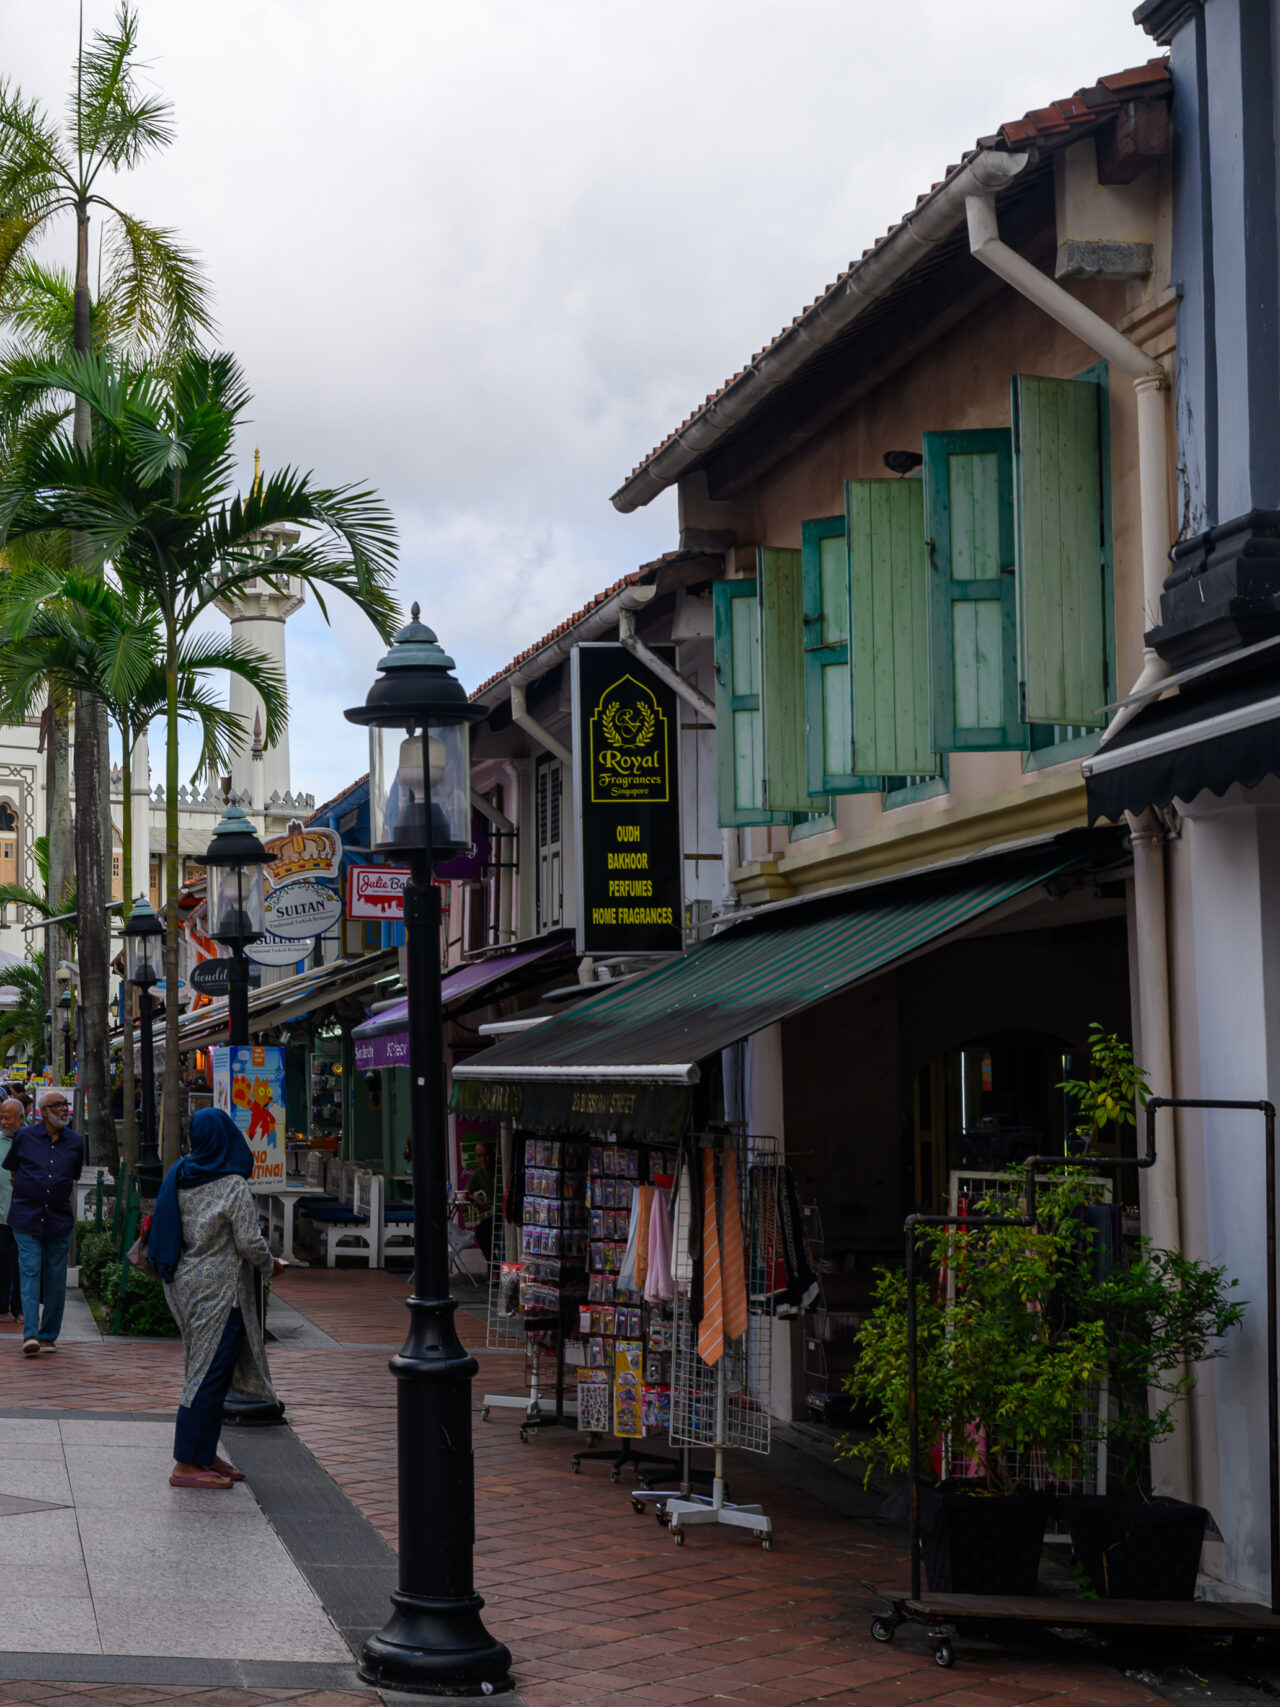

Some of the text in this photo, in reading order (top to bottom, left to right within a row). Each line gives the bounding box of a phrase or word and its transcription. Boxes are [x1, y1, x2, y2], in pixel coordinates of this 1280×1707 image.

[598, 750, 660, 775] Royal
[598, 773, 662, 788] Fragrances
[610, 786, 650, 798] Singapore
[616, 825, 641, 842] OUDH
[607, 852, 649, 870] BAKHOOR
[359, 875, 389, 892] Julie
[608, 880, 654, 897] PERFUMES
[276, 901, 326, 918] SULTAN
[592, 907, 673, 925] HOME FRAGRANCES
[252, 1150, 268, 1164] NO
[249, 1163, 284, 1179] UTING!
